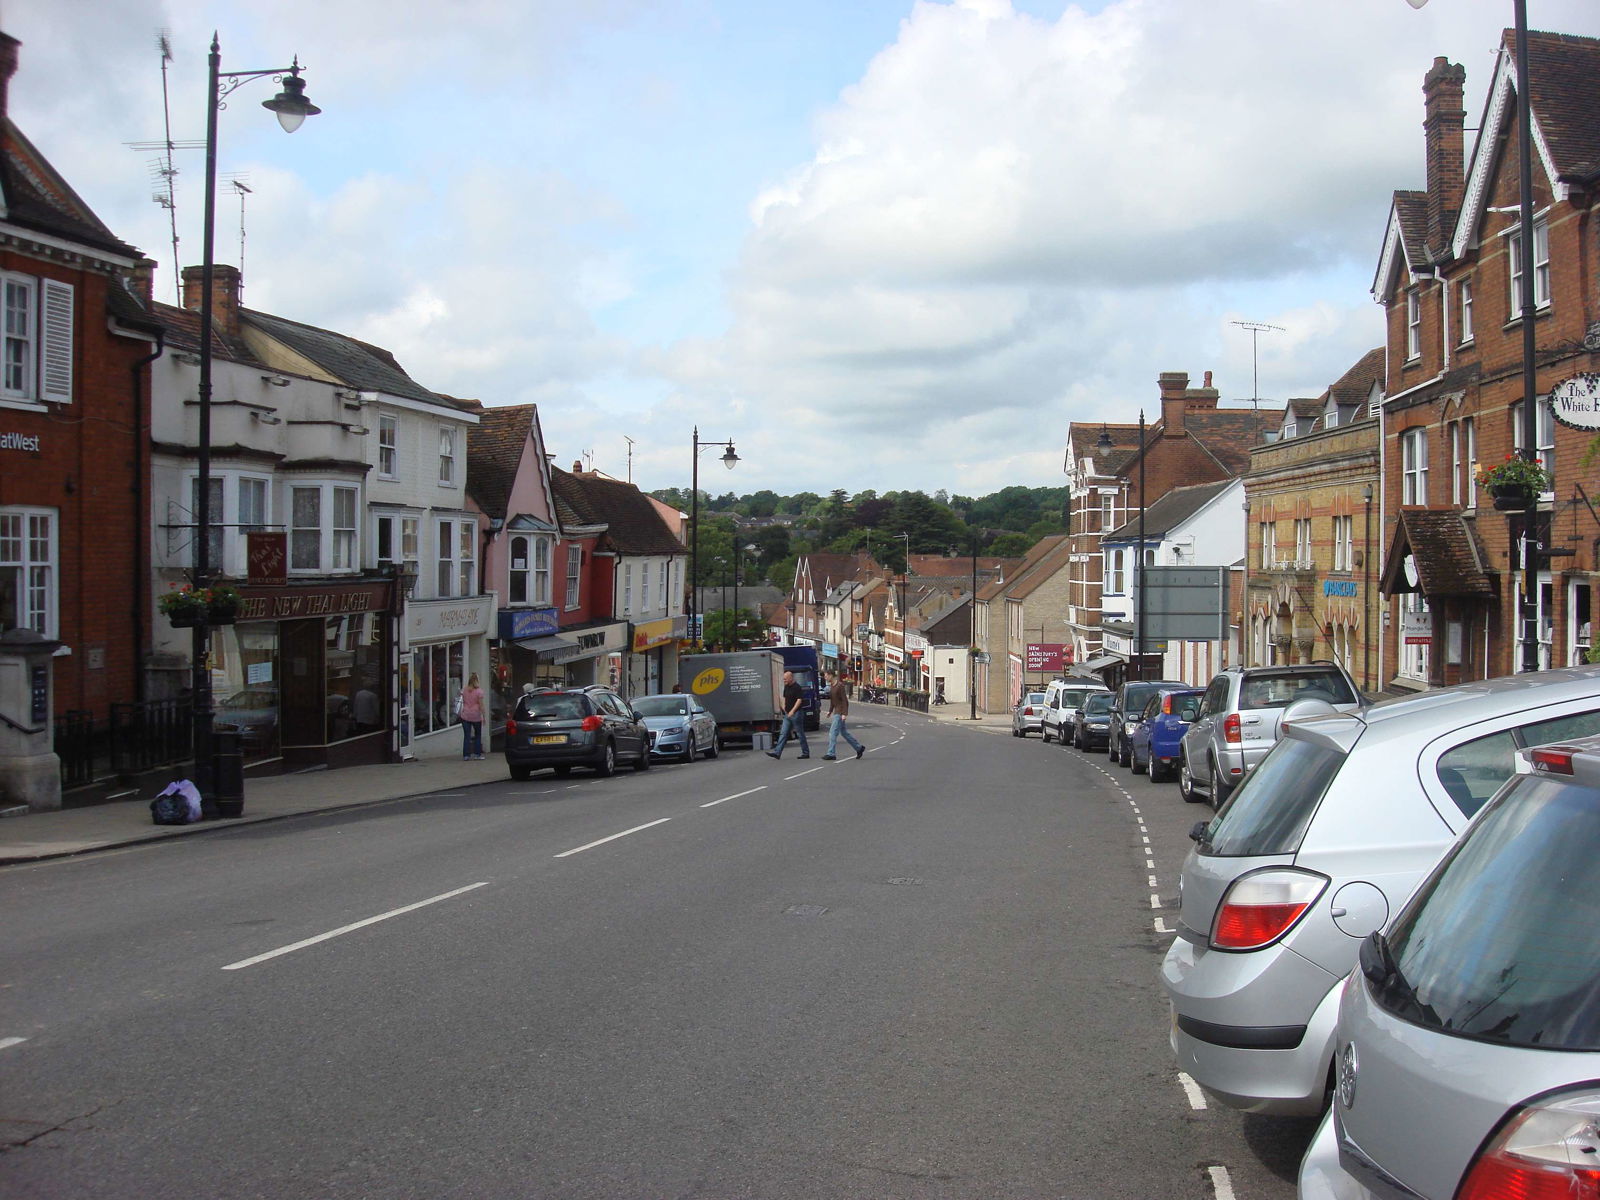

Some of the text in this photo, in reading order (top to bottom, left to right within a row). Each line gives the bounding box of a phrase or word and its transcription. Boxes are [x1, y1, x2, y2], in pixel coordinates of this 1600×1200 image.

[1566, 382, 1586, 397] The
[1560, 397, 1590, 412] White
[0, 432, 40, 451] atWest
[240, 591, 373, 618] THE NEW THAI LIGHT
[700, 673, 719, 688] phs
